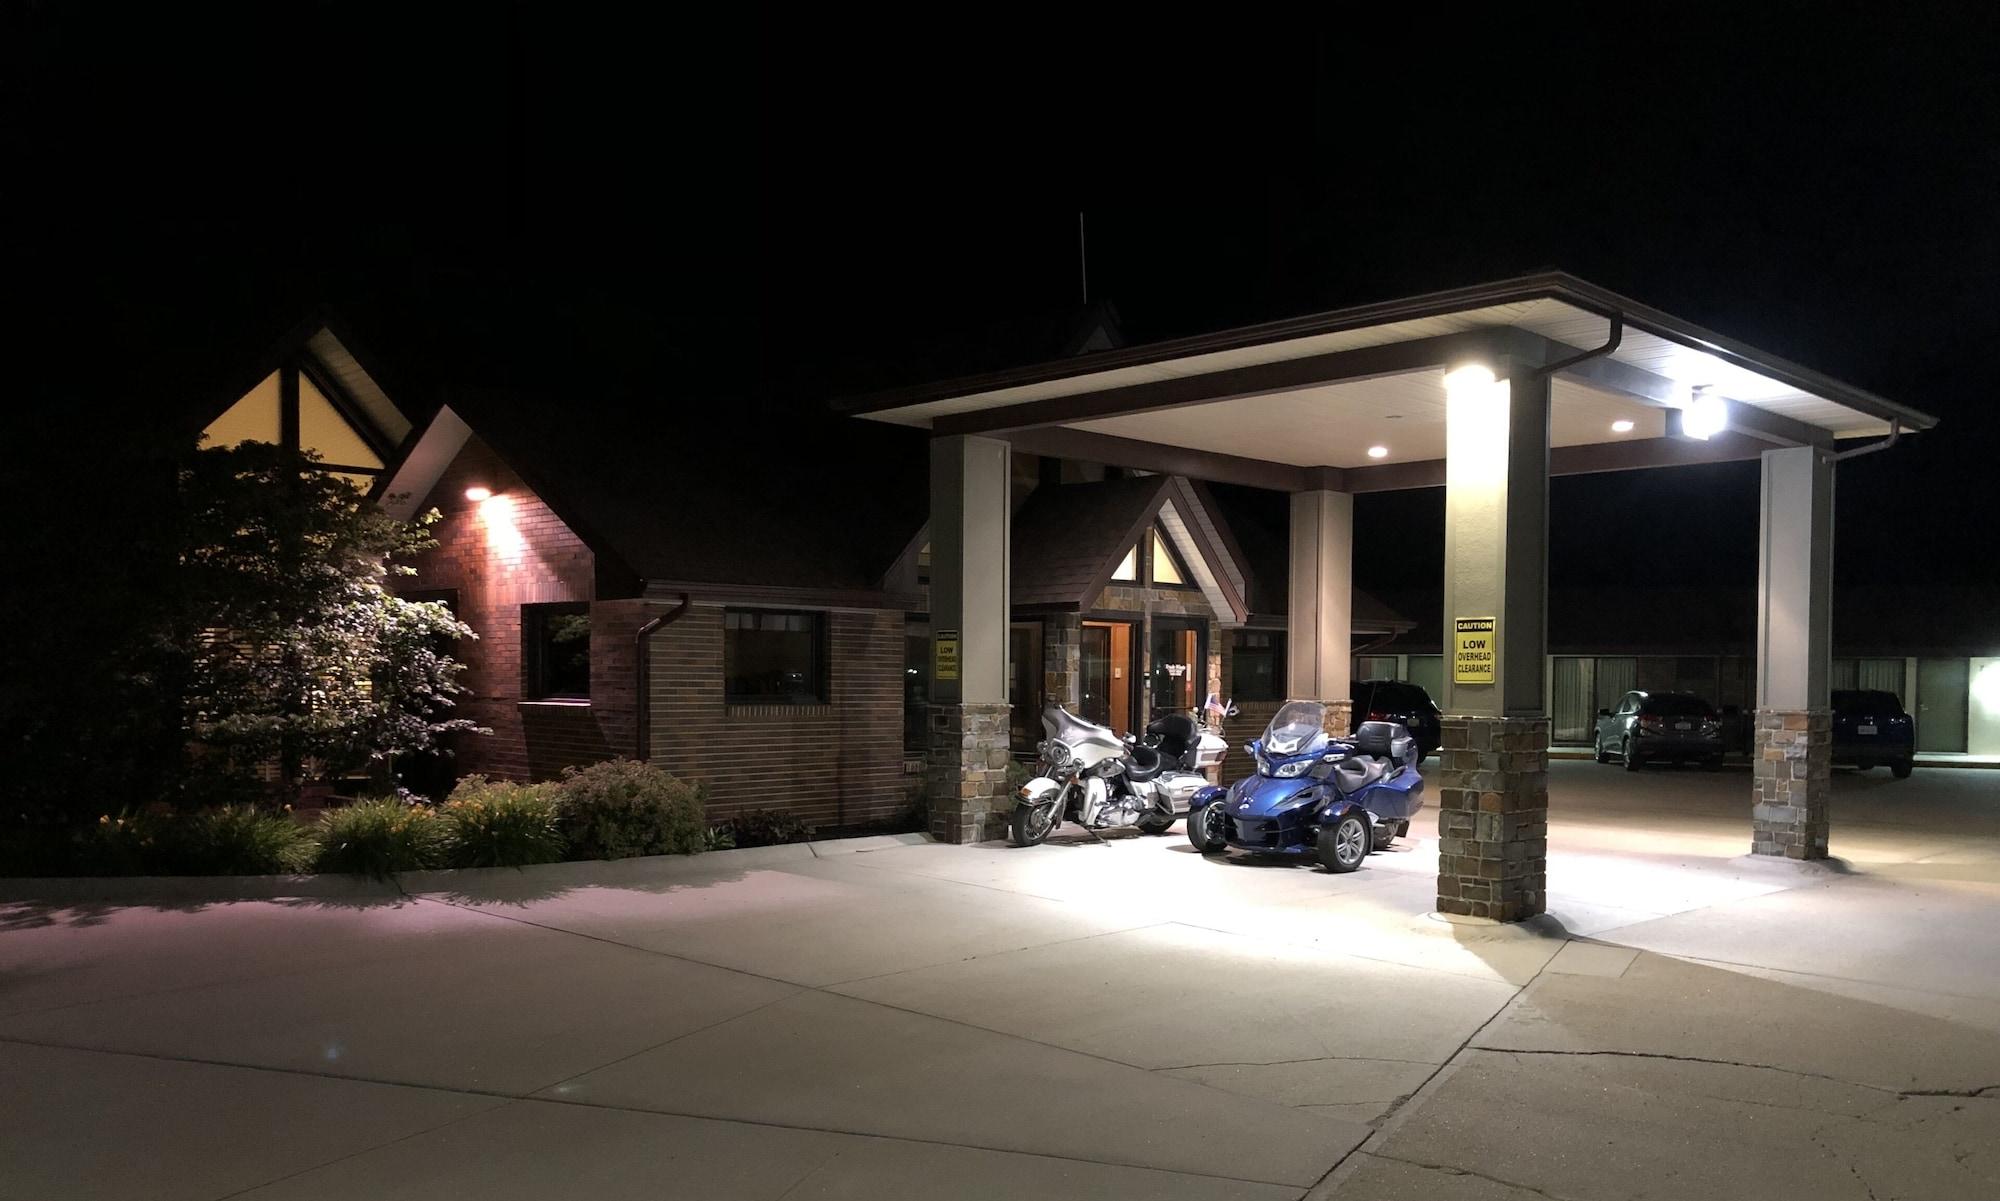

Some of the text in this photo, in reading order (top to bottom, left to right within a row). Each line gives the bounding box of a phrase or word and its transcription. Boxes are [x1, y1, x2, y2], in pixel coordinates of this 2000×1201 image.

[1458, 622, 1492, 630] CAUTION
[1463, 640, 1486, 649] LOW
[1458, 652, 1492, 661] OVERHEAD
[1458, 664, 1491, 673] CLEARANCE
